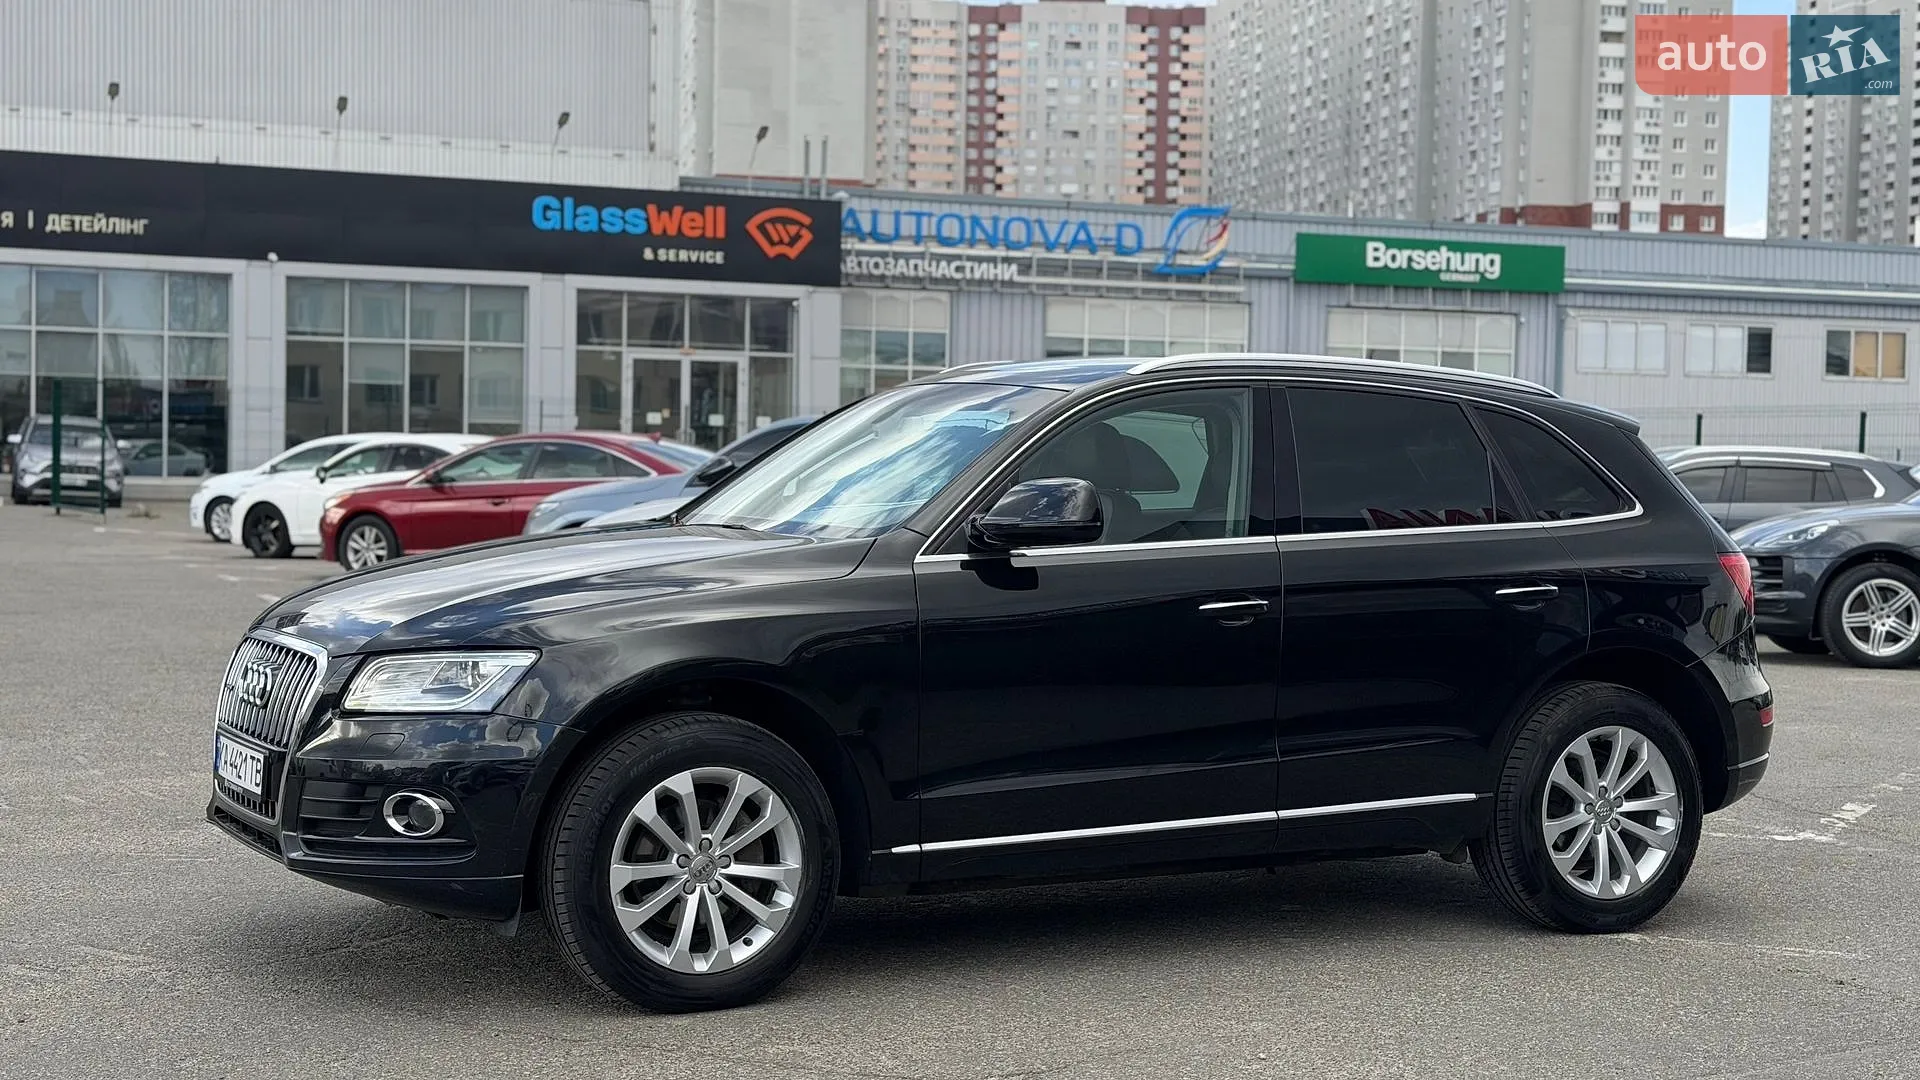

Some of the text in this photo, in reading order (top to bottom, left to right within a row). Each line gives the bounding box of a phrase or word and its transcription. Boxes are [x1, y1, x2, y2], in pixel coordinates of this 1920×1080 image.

[45, 212, 149, 236] ДЕТЕЙЛІНГ
[531, 195, 727, 239] GlassWell
[842, 207, 1145, 256] AUTONOVA-D
[643, 247, 725, 265] & SERVICE
[1365, 241, 1502, 279] Borsehung
